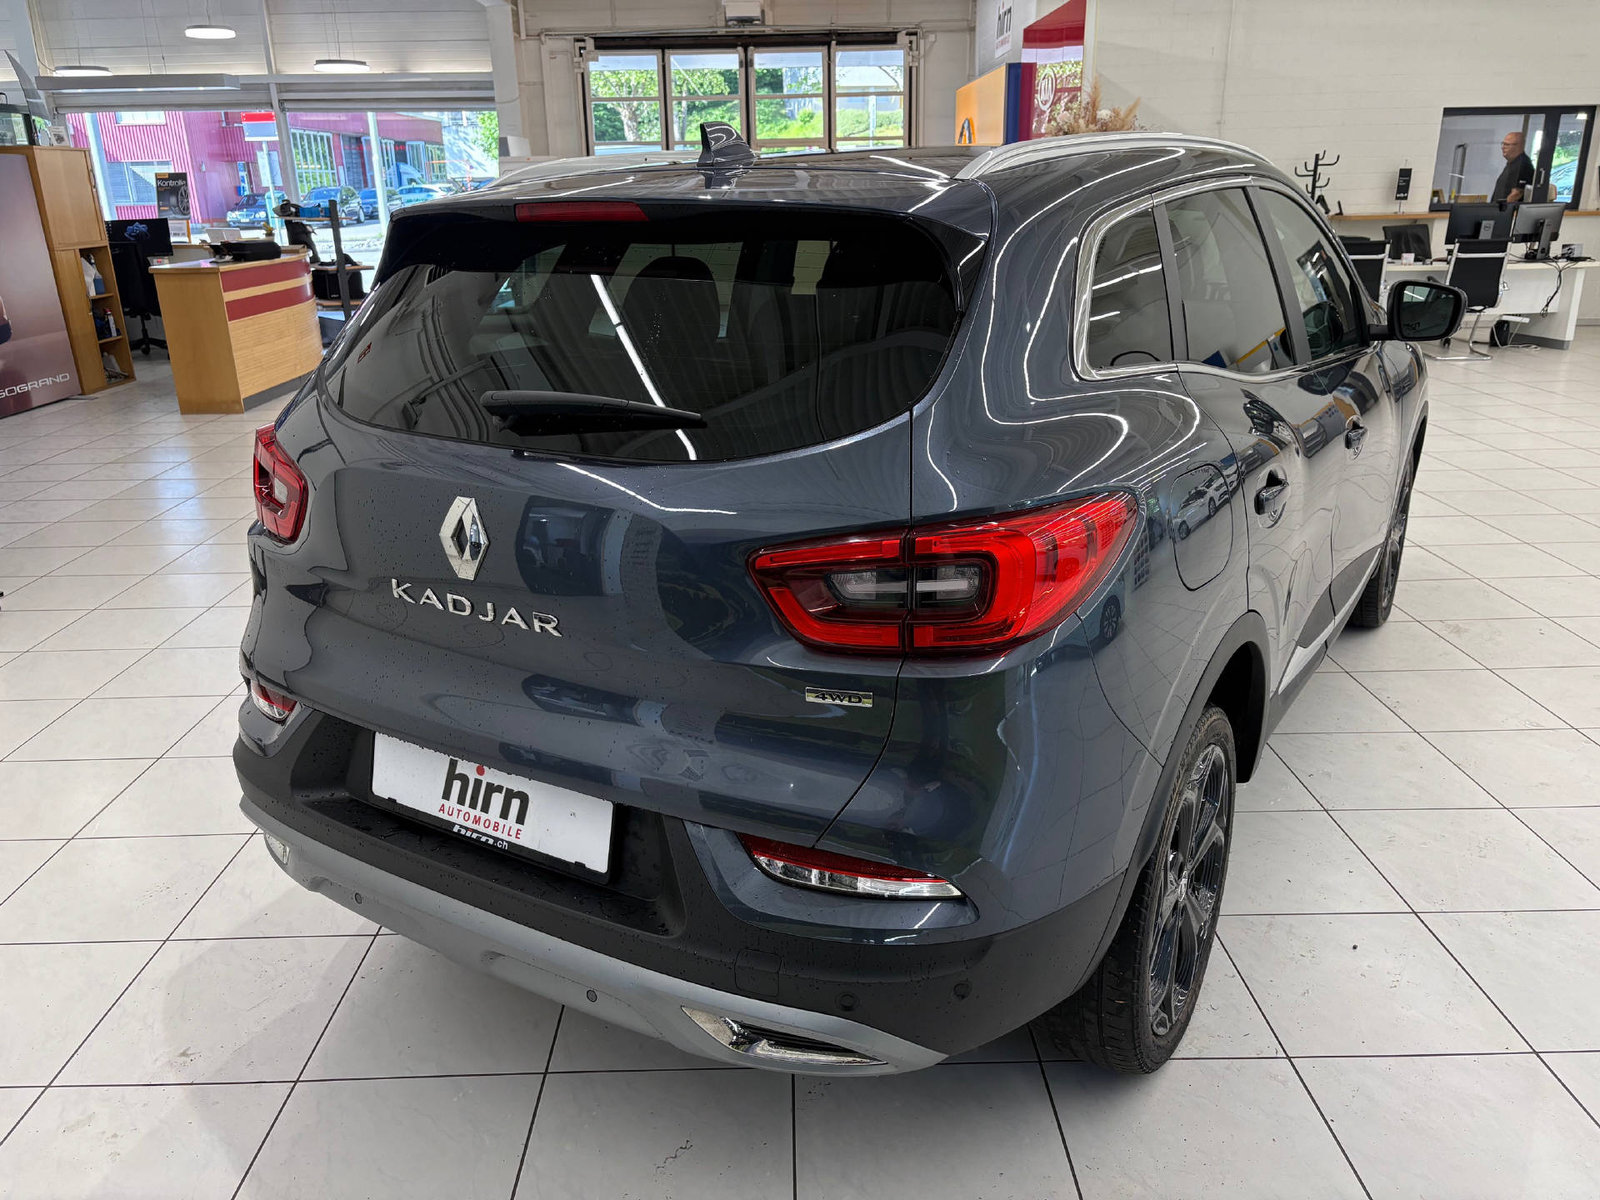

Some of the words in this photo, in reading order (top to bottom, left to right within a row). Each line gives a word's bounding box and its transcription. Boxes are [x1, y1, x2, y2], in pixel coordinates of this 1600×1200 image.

[391, 578, 562, 637] KADJAR
[814, 692, 863, 704] 4WD
[441, 758, 530, 826] hirn
[439, 803, 523, 840] AUTOMOBILE
